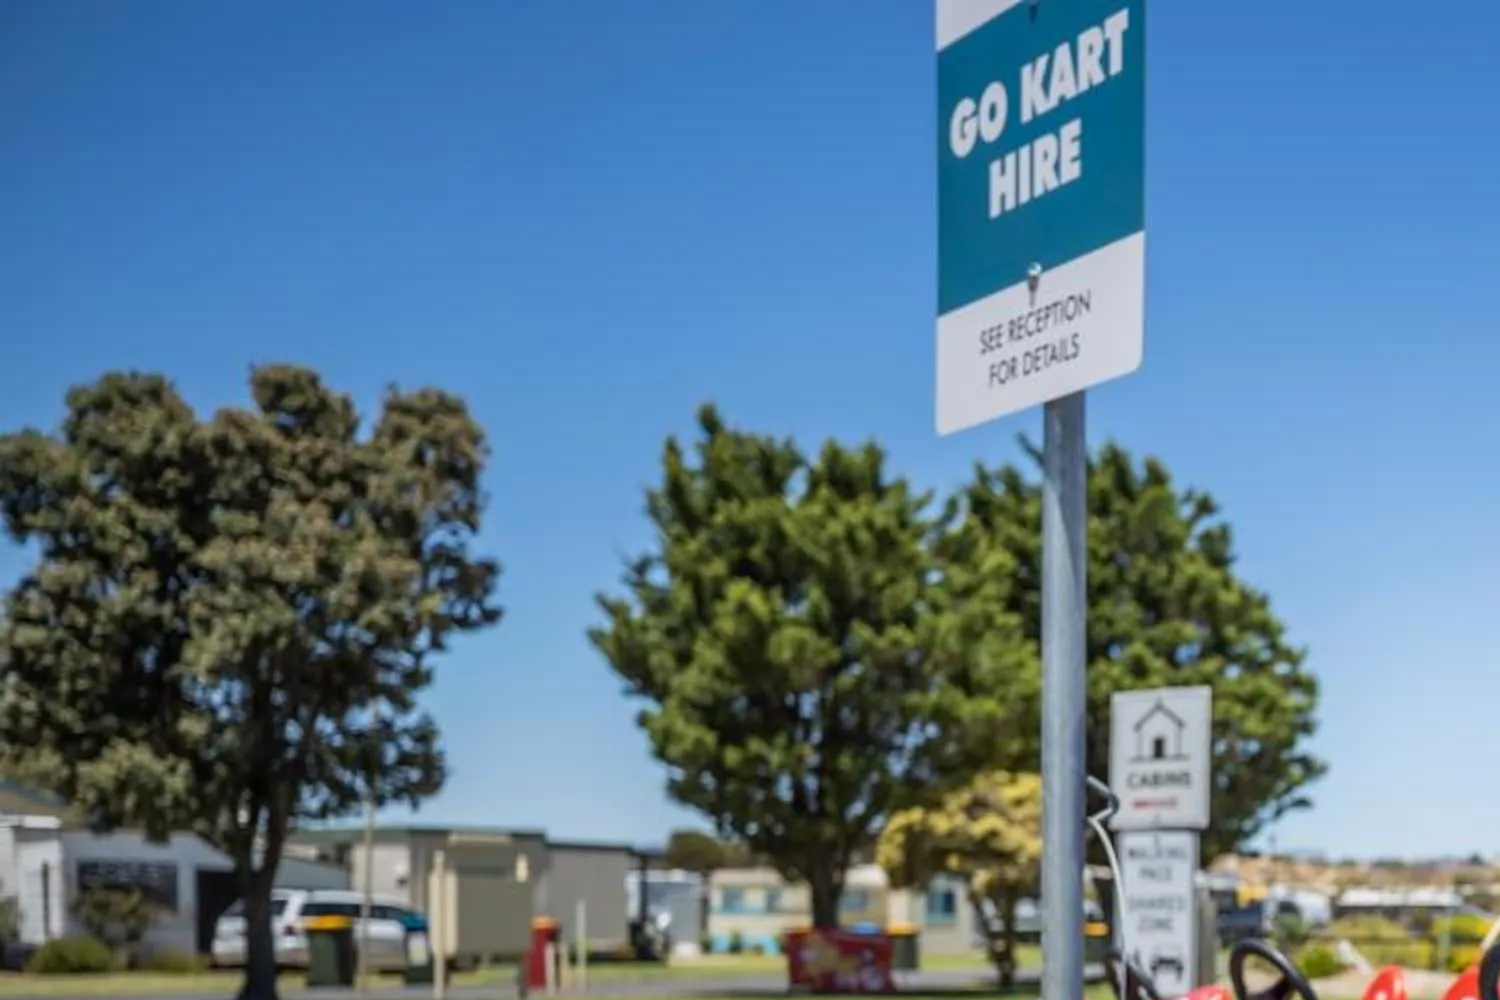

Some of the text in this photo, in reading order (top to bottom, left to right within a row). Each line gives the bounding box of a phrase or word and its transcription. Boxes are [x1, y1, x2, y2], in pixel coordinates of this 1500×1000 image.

[949, 7, 1129, 159] GO KART
[988, 118, 1082, 219] HIRE
[979, 289, 1091, 355] SEE RECEPTION
[988, 333, 1080, 388] FOR DETAILS
